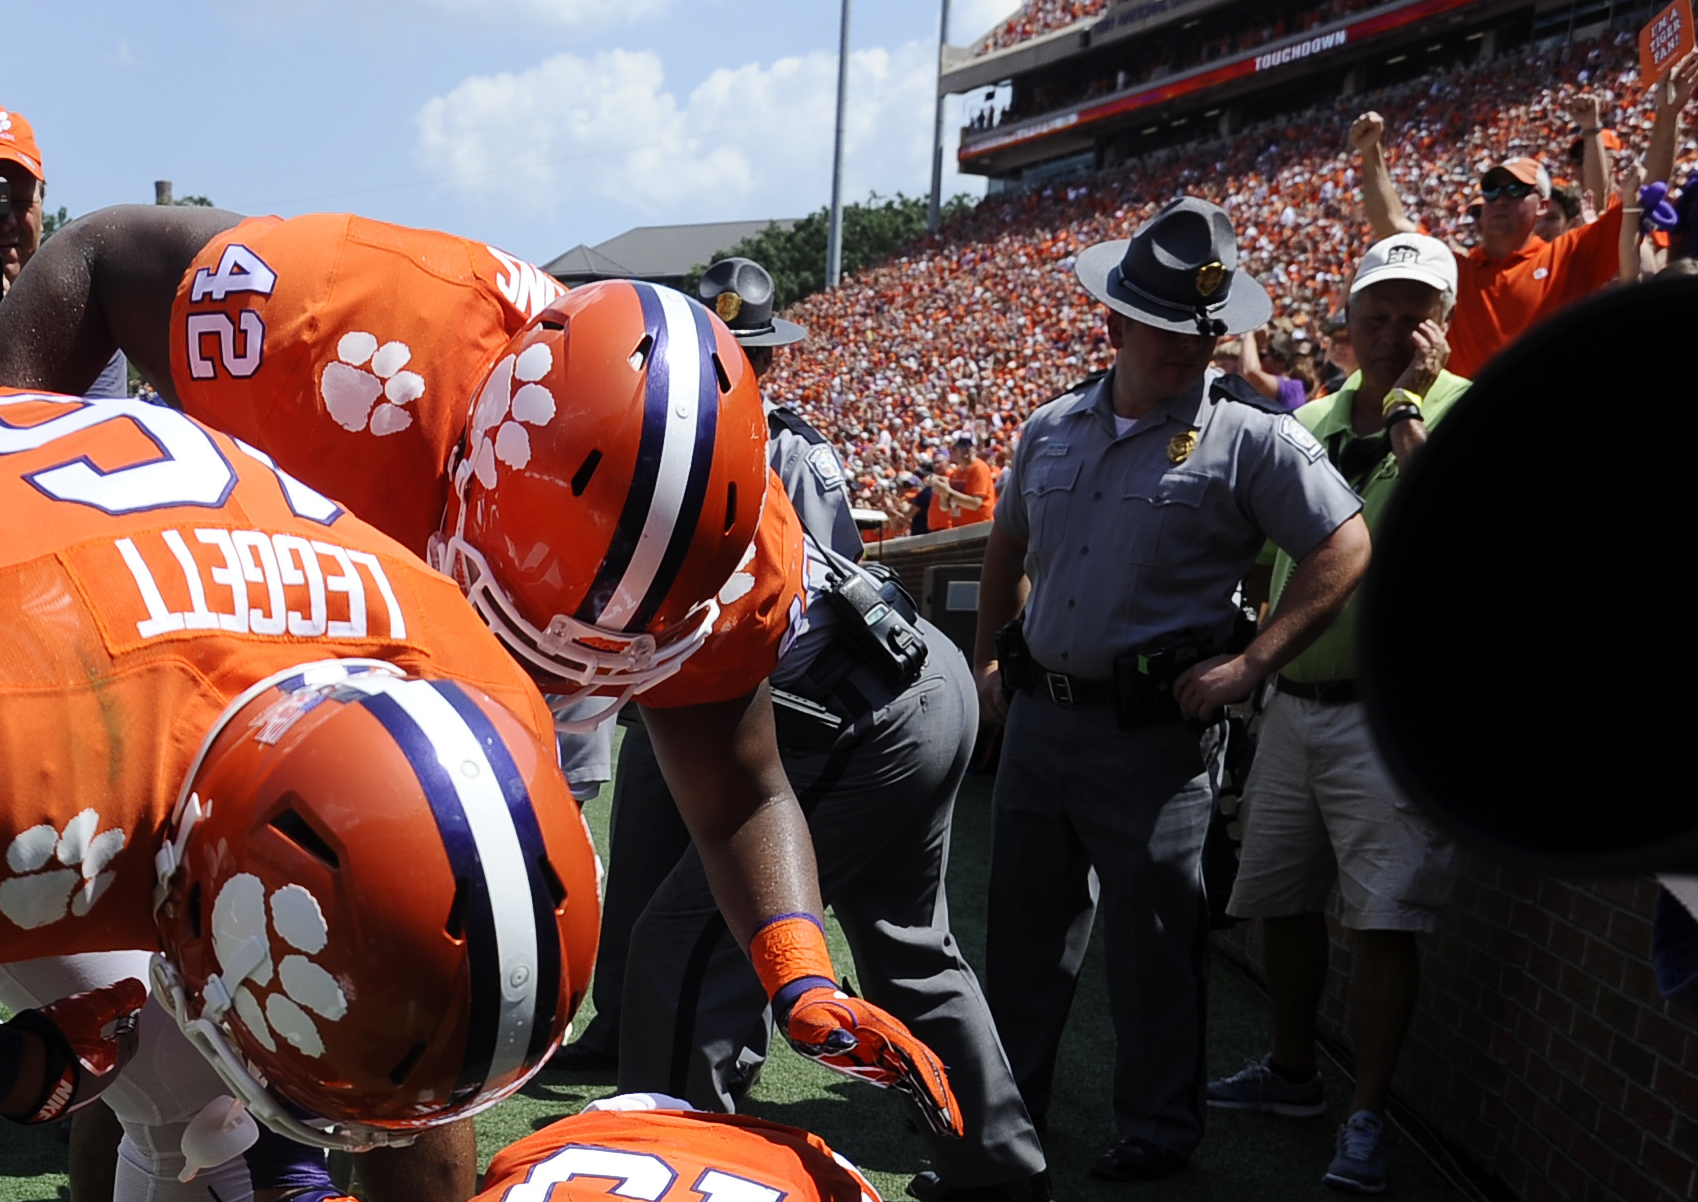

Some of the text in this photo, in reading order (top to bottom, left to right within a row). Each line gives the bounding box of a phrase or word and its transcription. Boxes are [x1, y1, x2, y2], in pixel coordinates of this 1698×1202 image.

[1255, 29, 1346, 71] TOUCHDOWN
[1649, 19, 1681, 54] TIGER
[186, 243, 279, 381] 42
[114, 527, 407, 639] LEGGETT
[38, 1078, 73, 1121] NIKE
